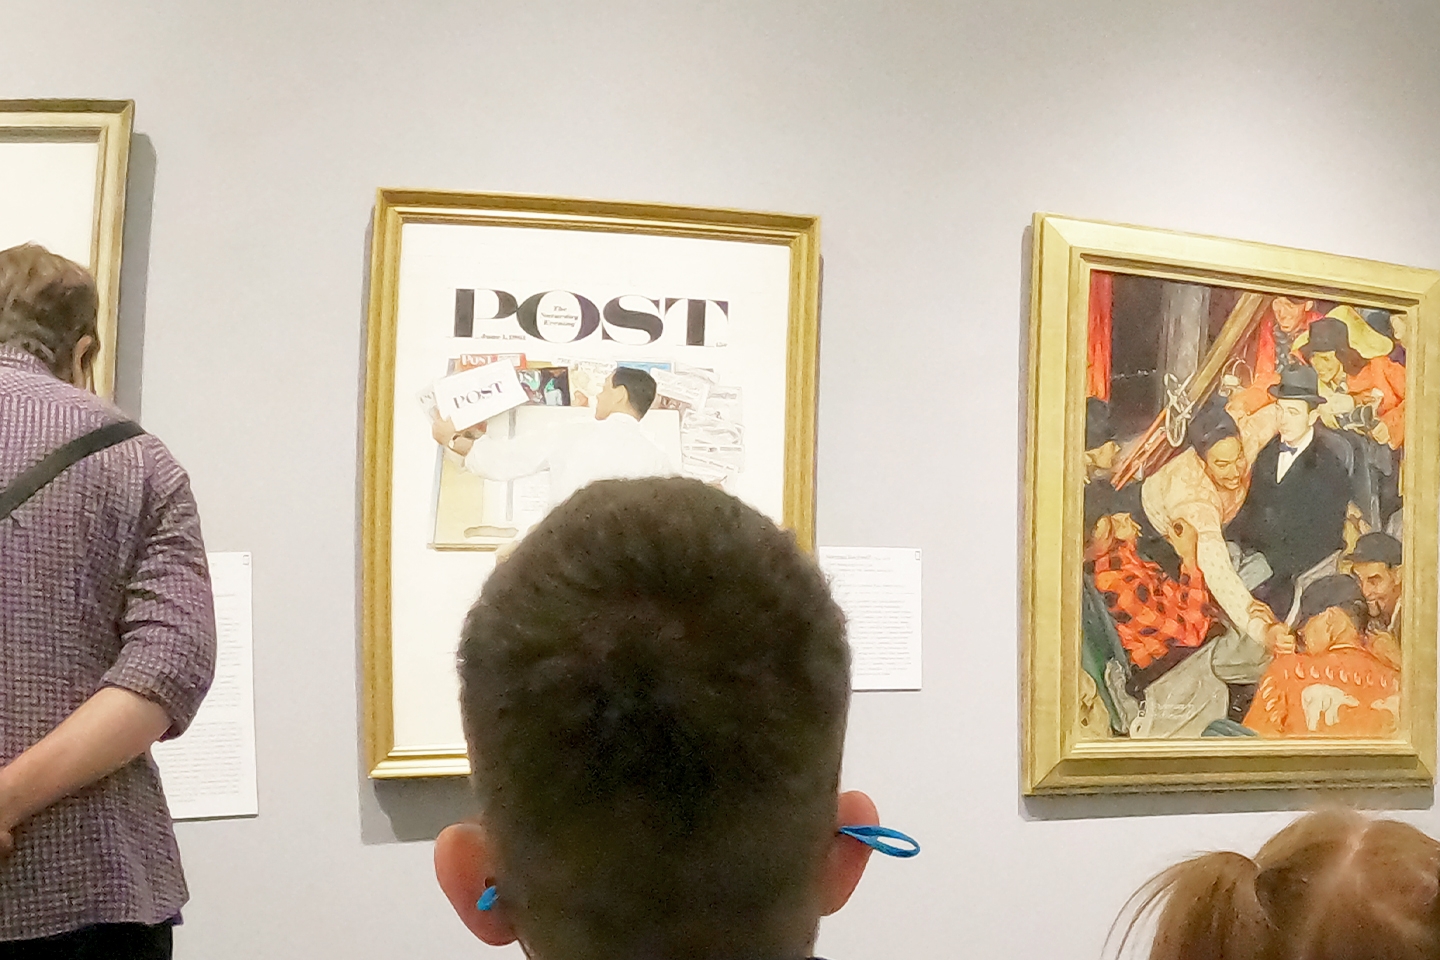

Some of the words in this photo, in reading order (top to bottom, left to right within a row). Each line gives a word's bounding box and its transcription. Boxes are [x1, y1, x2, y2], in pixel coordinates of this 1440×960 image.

[452, 288, 729, 347] POST
[461, 354, 493, 366] POST
[452, 380, 504, 409] POST
